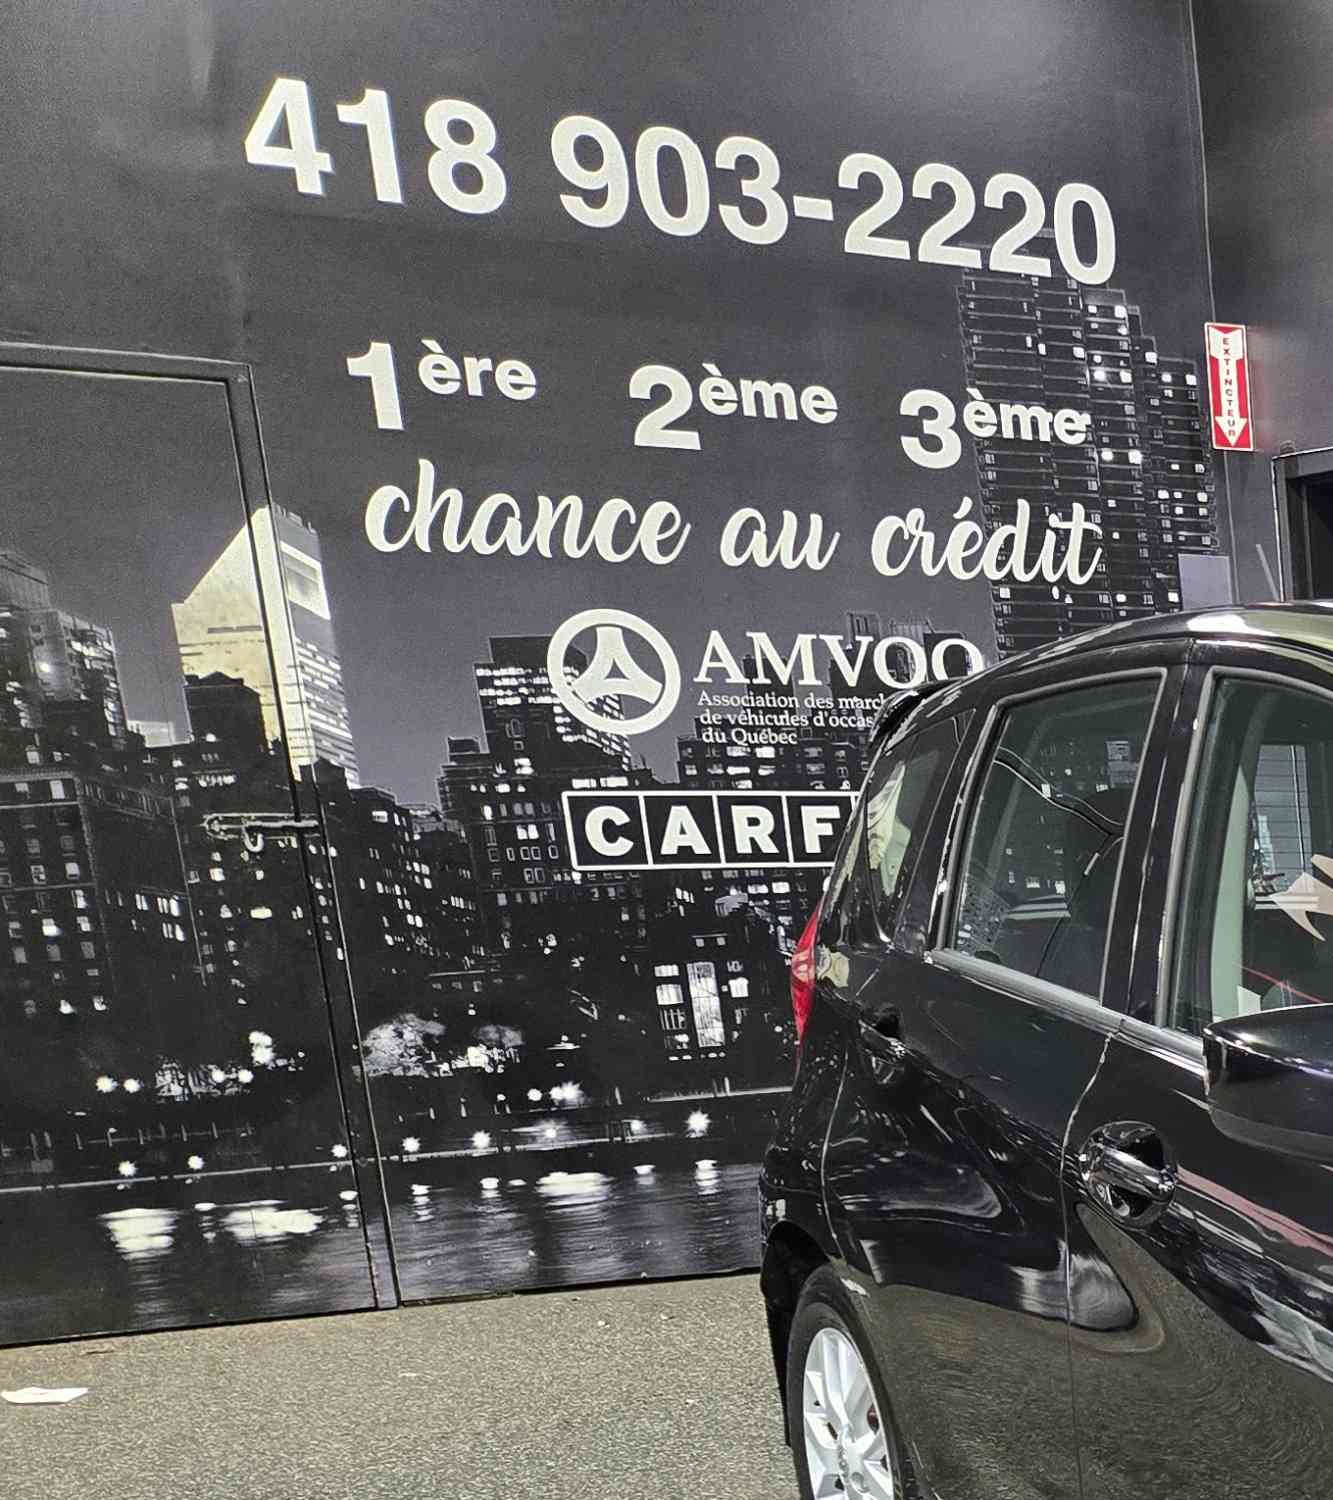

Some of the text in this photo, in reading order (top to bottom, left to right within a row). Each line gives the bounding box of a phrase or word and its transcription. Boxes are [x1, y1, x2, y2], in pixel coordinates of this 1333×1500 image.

[244, 77, 1116, 285] 418 903-2220
[346, 340, 1092, 469] 1ère 2ème 3ème
[1221, 337, 1236, 437] EXTINCTEUR
[364, 458, 1103, 585] chance au crédit
[697, 690, 799, 709] Association
[803, 692, 834, 710] des
[699, 708, 876, 728] de véhicules d'occas
[702, 727, 798, 745] du Québec
[584, 804, 842, 857] CARF
